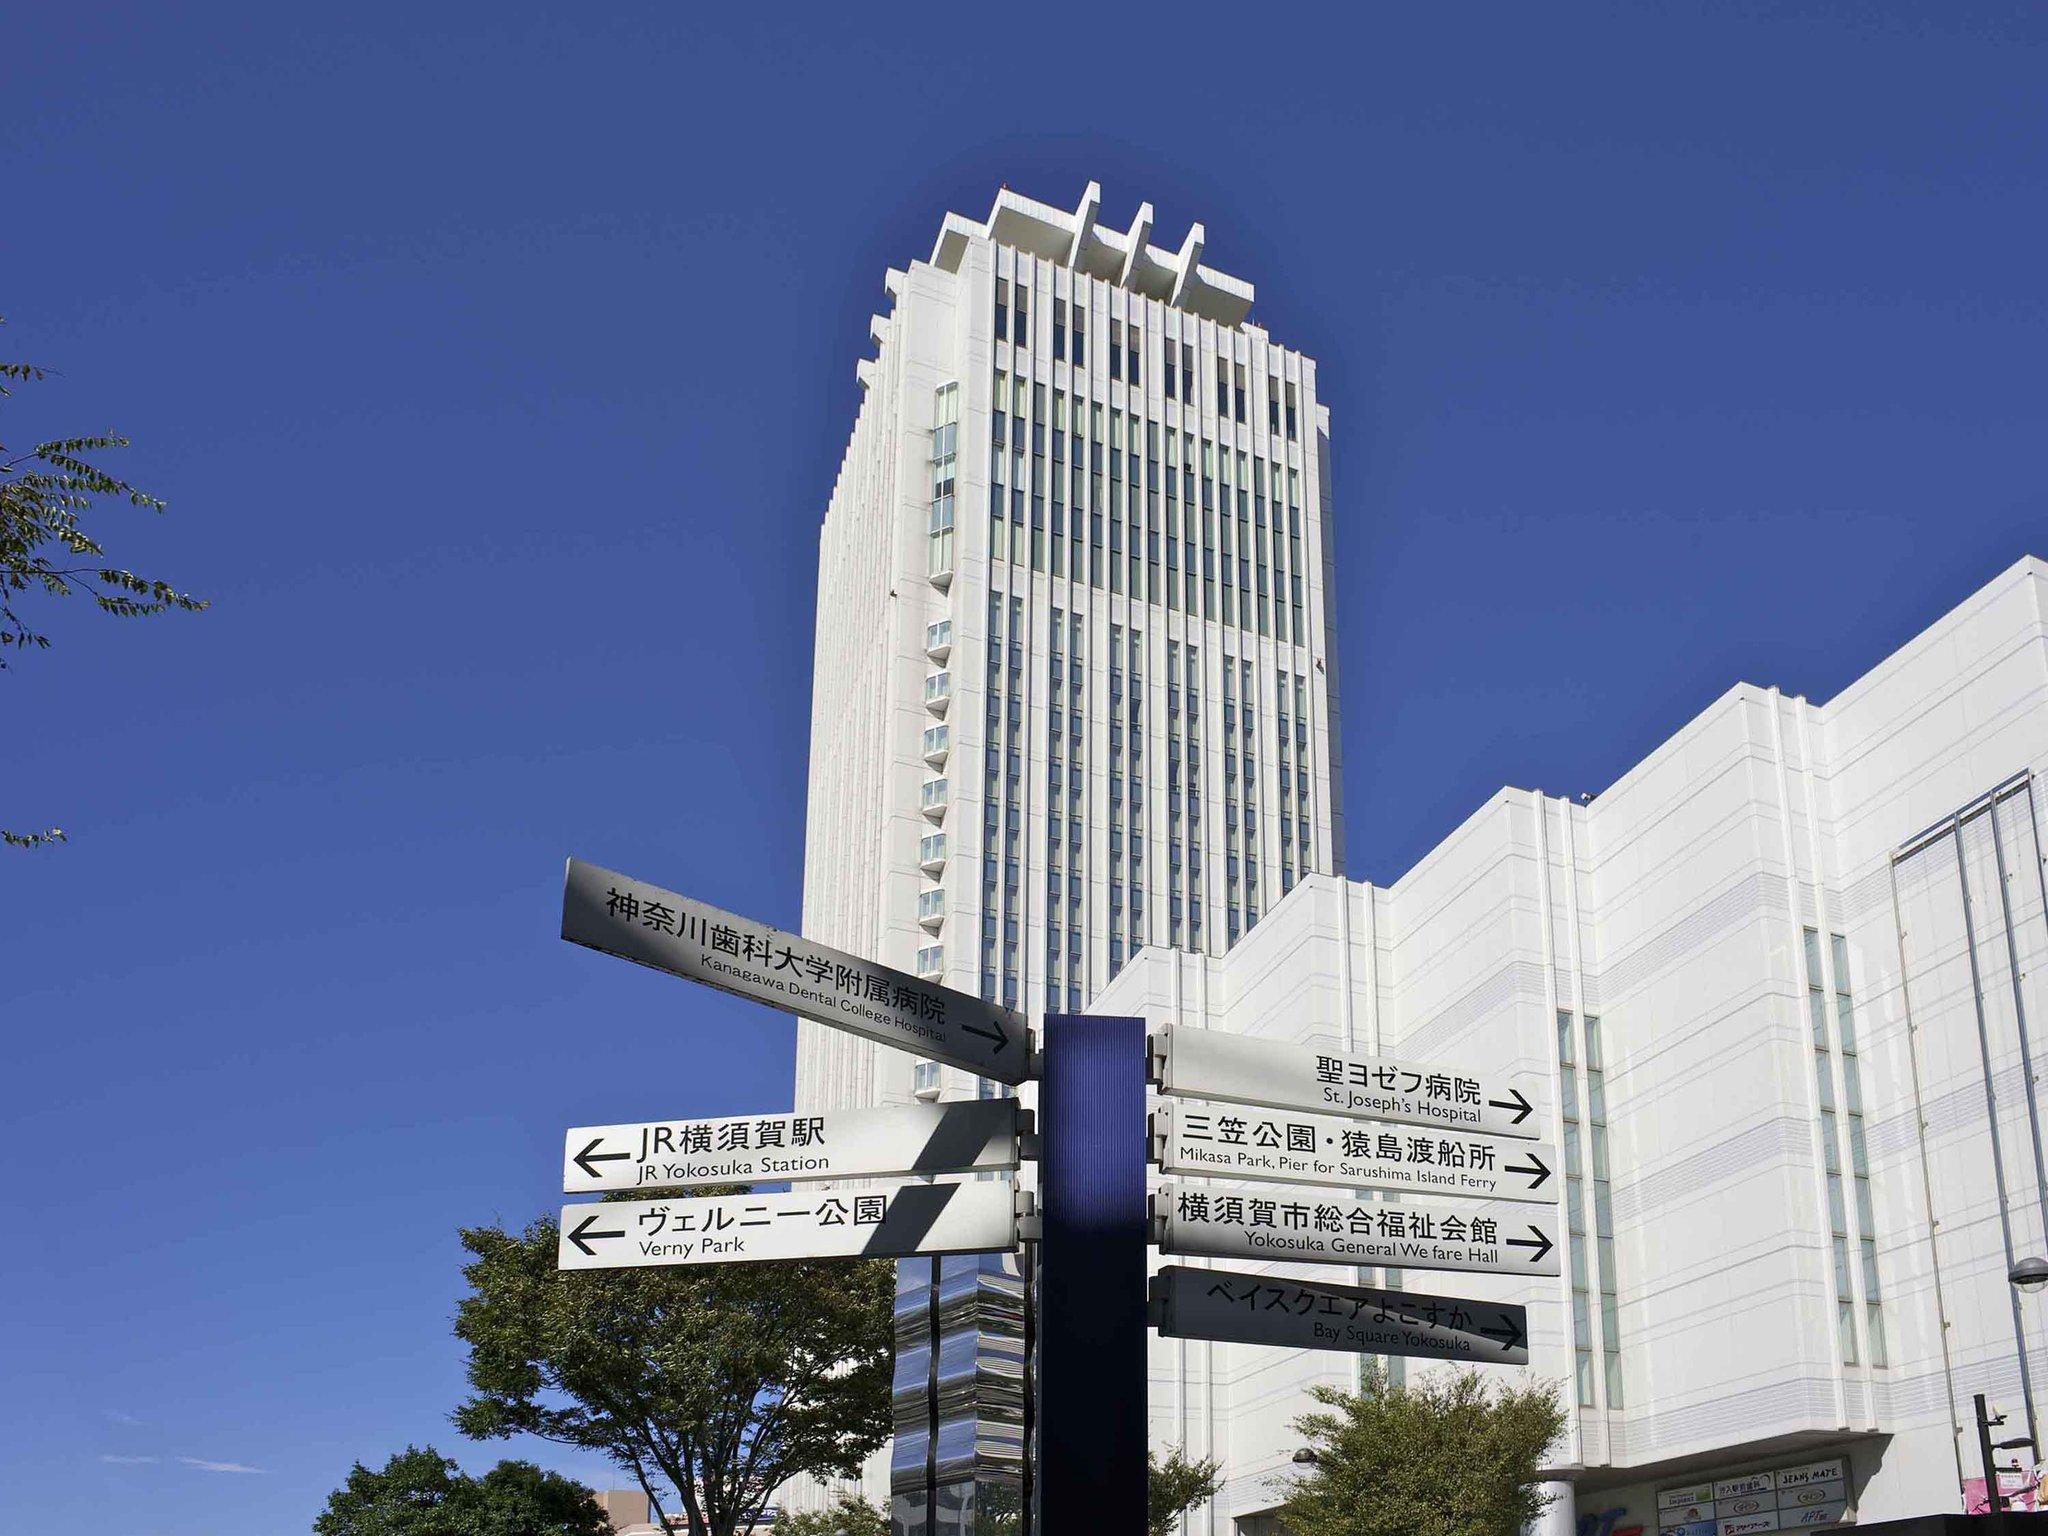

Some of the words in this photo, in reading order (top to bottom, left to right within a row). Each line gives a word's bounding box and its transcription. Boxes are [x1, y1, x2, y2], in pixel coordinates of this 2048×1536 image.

[605, 887, 946, 1026] 神奈川歯科大学附属病院
[701, 953, 785, 992] Kanagawa
[789, 981, 837, 1009] Dental
[840, 999, 891, 1026] College
[895, 1016, 946, 1042] Hospital
[1316, 1055, 1481, 1105] 聖ヨゼフ病院
[1324, 1088, 1344, 1103] St.
[1347, 1089, 1411, 1113] Joseph's
[1418, 1101, 1481, 1123] Hospital
[637, 1117, 825, 1164] JR横須賀駅
[637, 1165, 658, 1187] JR
[662, 1158, 752, 1180] Yokosuka
[761, 1156, 829, 1175] Station
[1180, 1147, 1232, 1165] Mikasa
[1237, 1153, 1275, 1171] Park,
[1279, 1156, 1309, 1171] Pier
[1313, 1160, 1335, 1175] for
[1340, 1163, 1412, 1182] Sarushima
[1417, 1169, 1455, 1186] Island
[1461, 1173, 1496, 1192] Ferry
[638, 1195, 887, 1238] ヴェルニー公園
[1178, 1192, 1498, 1245] 横須賀市総合福祉会館
[639, 1240, 694, 1259] Verny
[702, 1237, 744, 1254] Park
[1244, 1231, 1324, 1252] Yokosuka
[1331, 1238, 1396, 1257] General
[1469, 1247, 1498, 1264] Hall
[1207, 1280, 1472, 1330] ベイスクエアよこすか
[1314, 1323, 1340, 1342] Bay
[1346, 1326, 1399, 1347] Square
[1401, 1330, 1471, 1352] Yokosuka
[1782, 1473, 1809, 1484] JEANS
[1812, 1467, 1838, 1480] MATE
